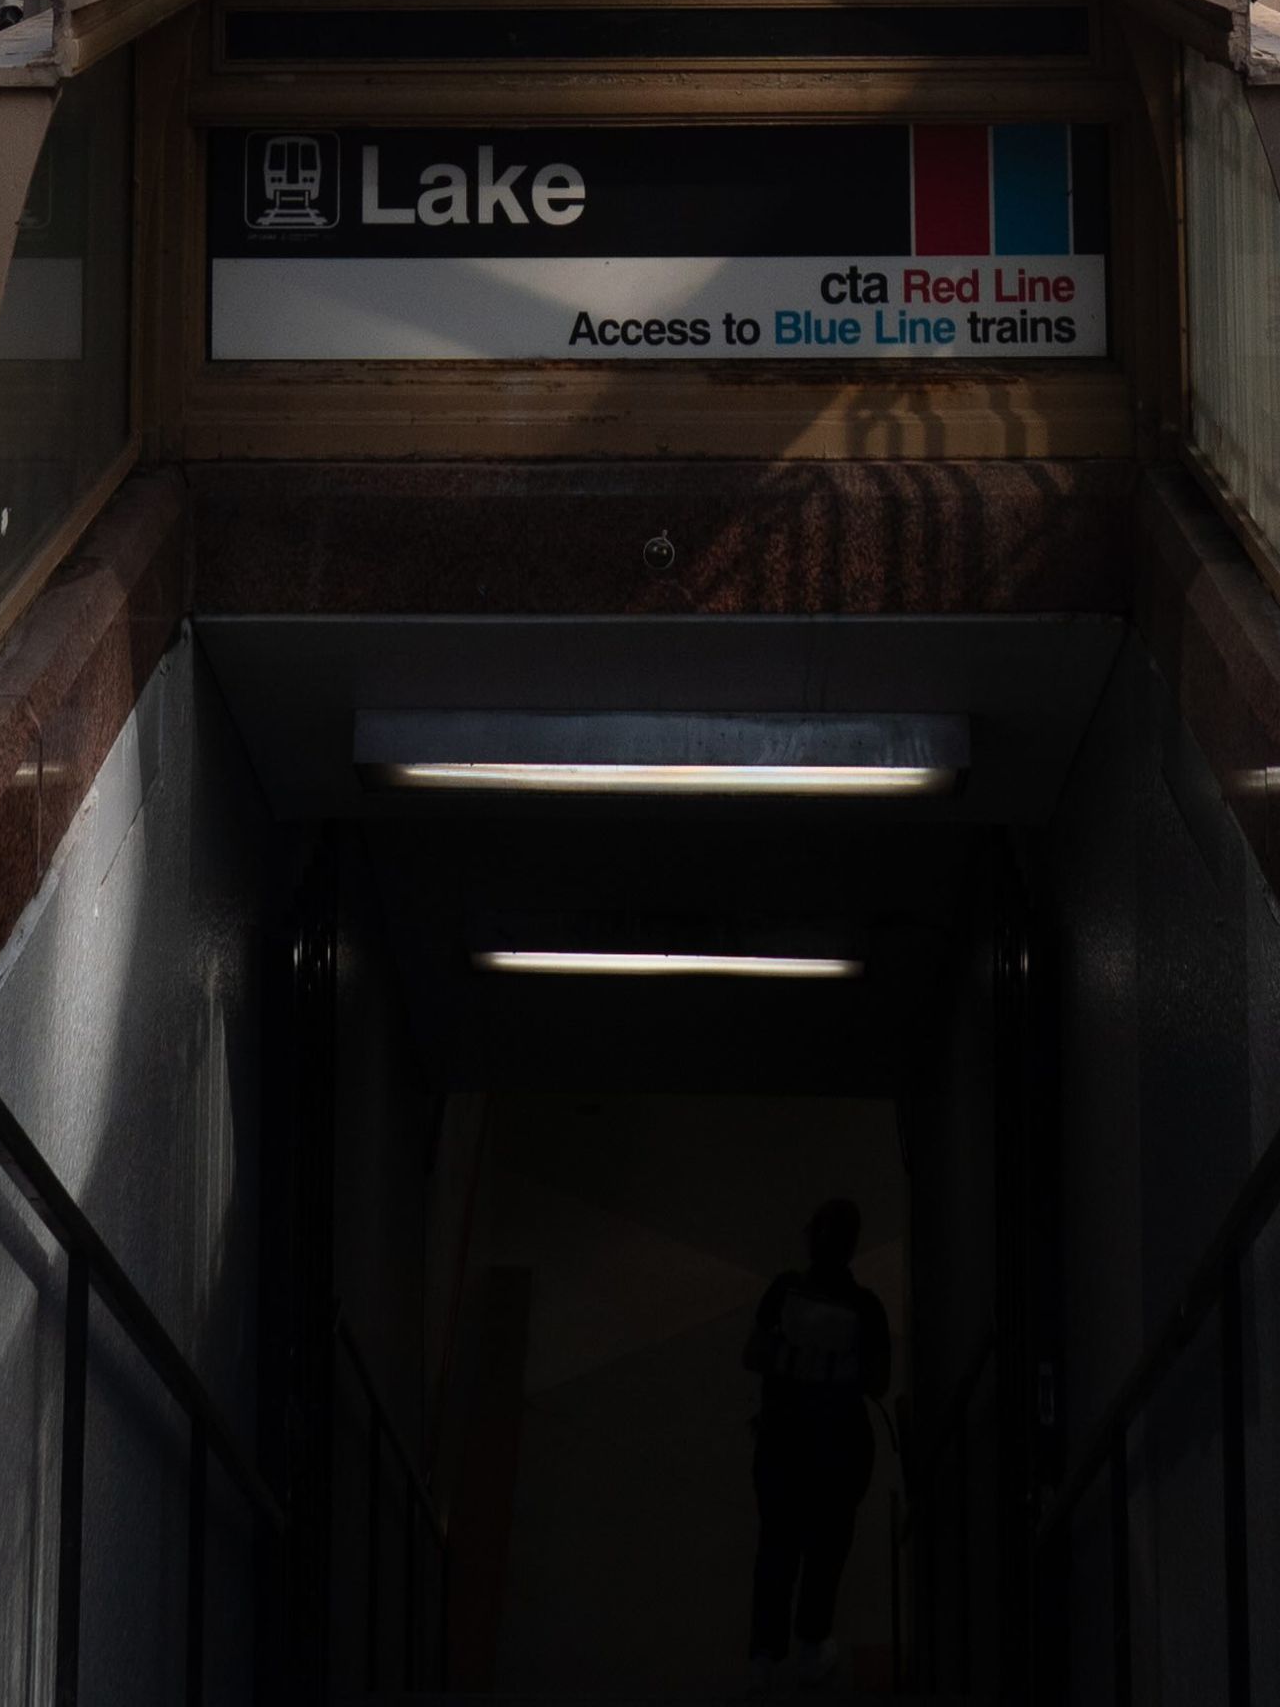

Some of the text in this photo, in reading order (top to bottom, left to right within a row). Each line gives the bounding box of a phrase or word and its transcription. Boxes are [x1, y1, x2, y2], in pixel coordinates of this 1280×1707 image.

[362, 145, 586, 226] Lake
[821, 265, 1076, 305] cta Red Line
[569, 309, 1077, 346] Access to Blue Line trains
